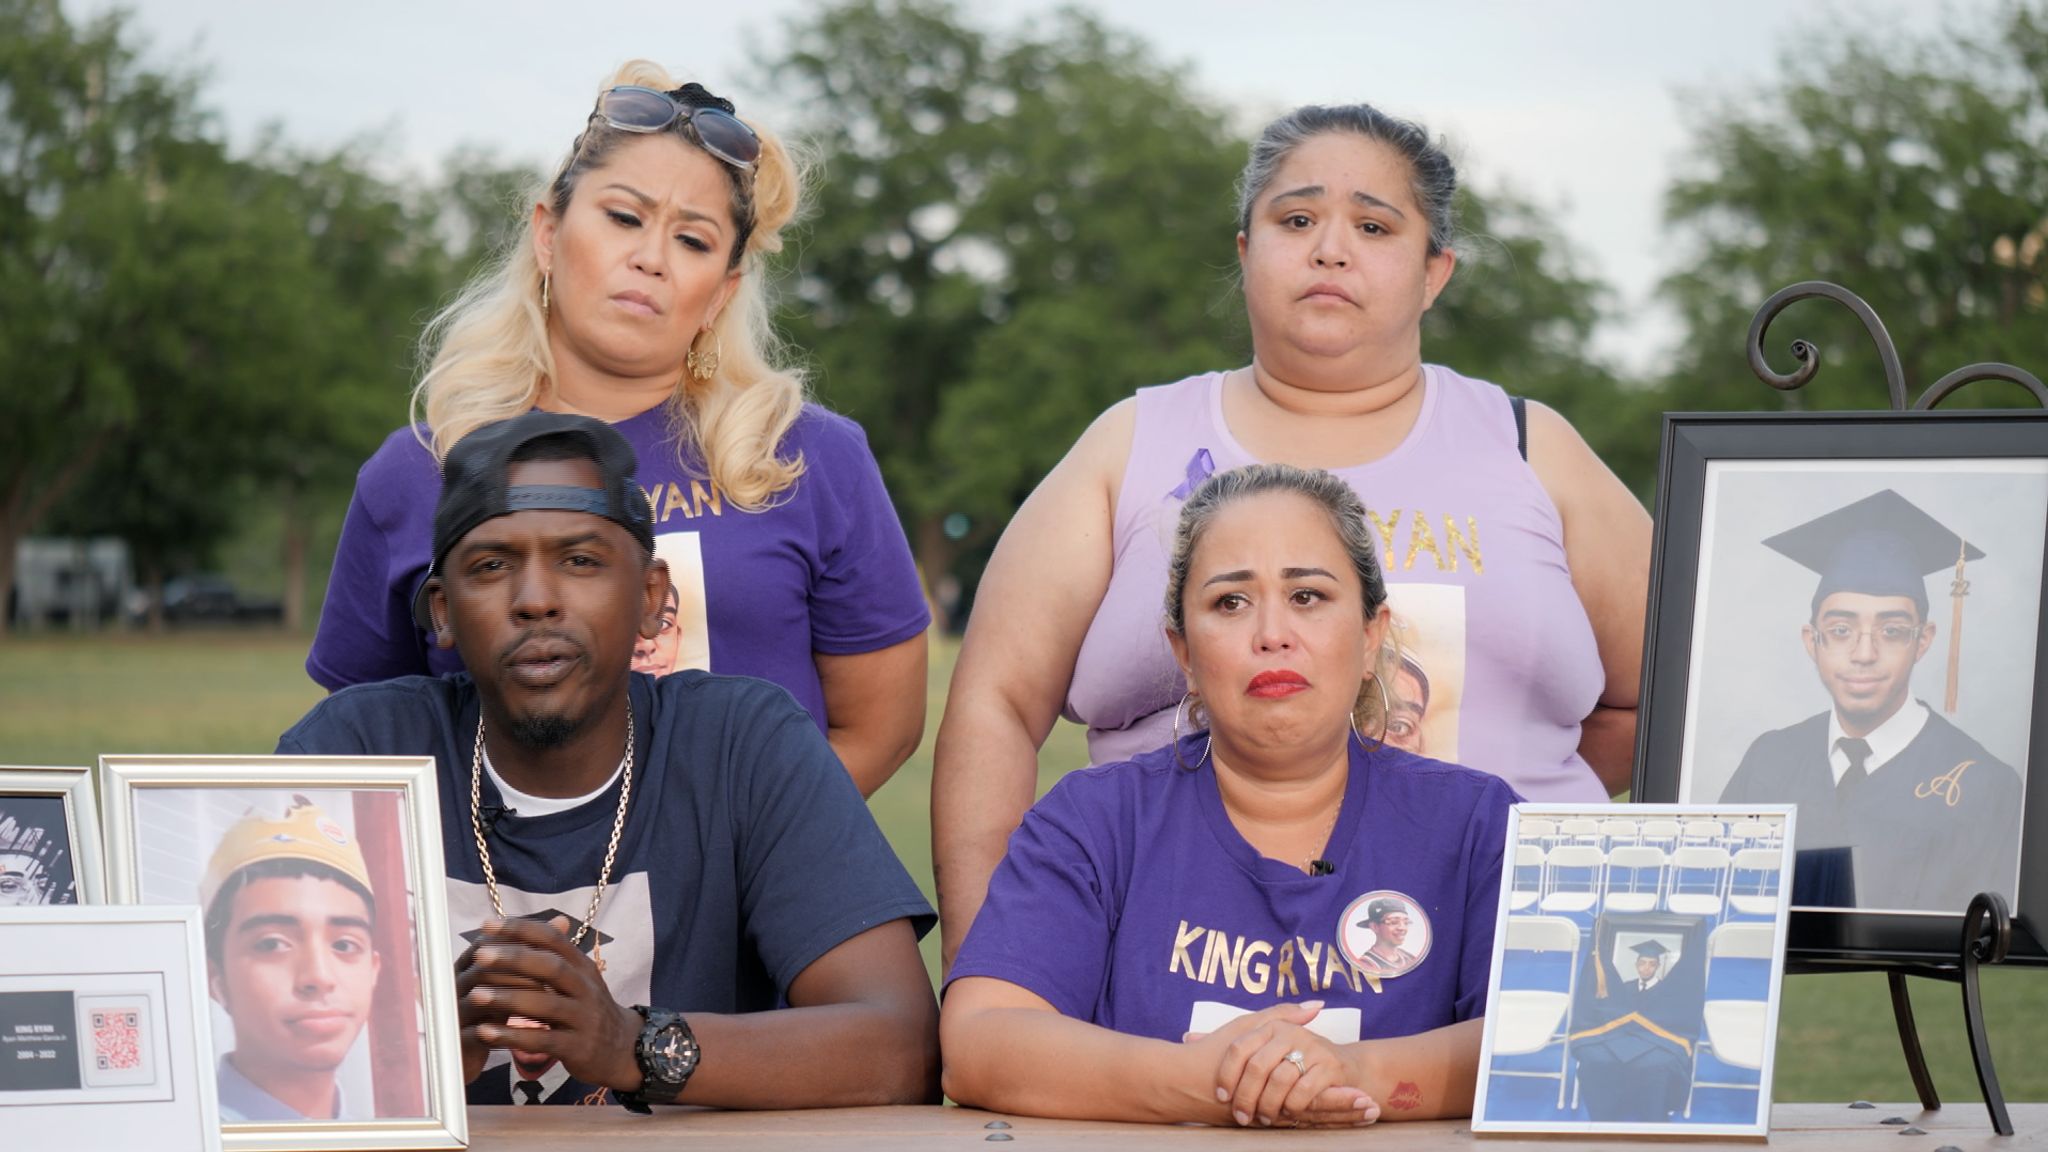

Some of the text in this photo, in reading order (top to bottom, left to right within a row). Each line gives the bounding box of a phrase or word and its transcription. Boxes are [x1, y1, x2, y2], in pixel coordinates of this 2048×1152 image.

[639, 480, 722, 524] YAN
[1368, 509, 1484, 576] YAN
[1169, 920, 1274, 994] KING
